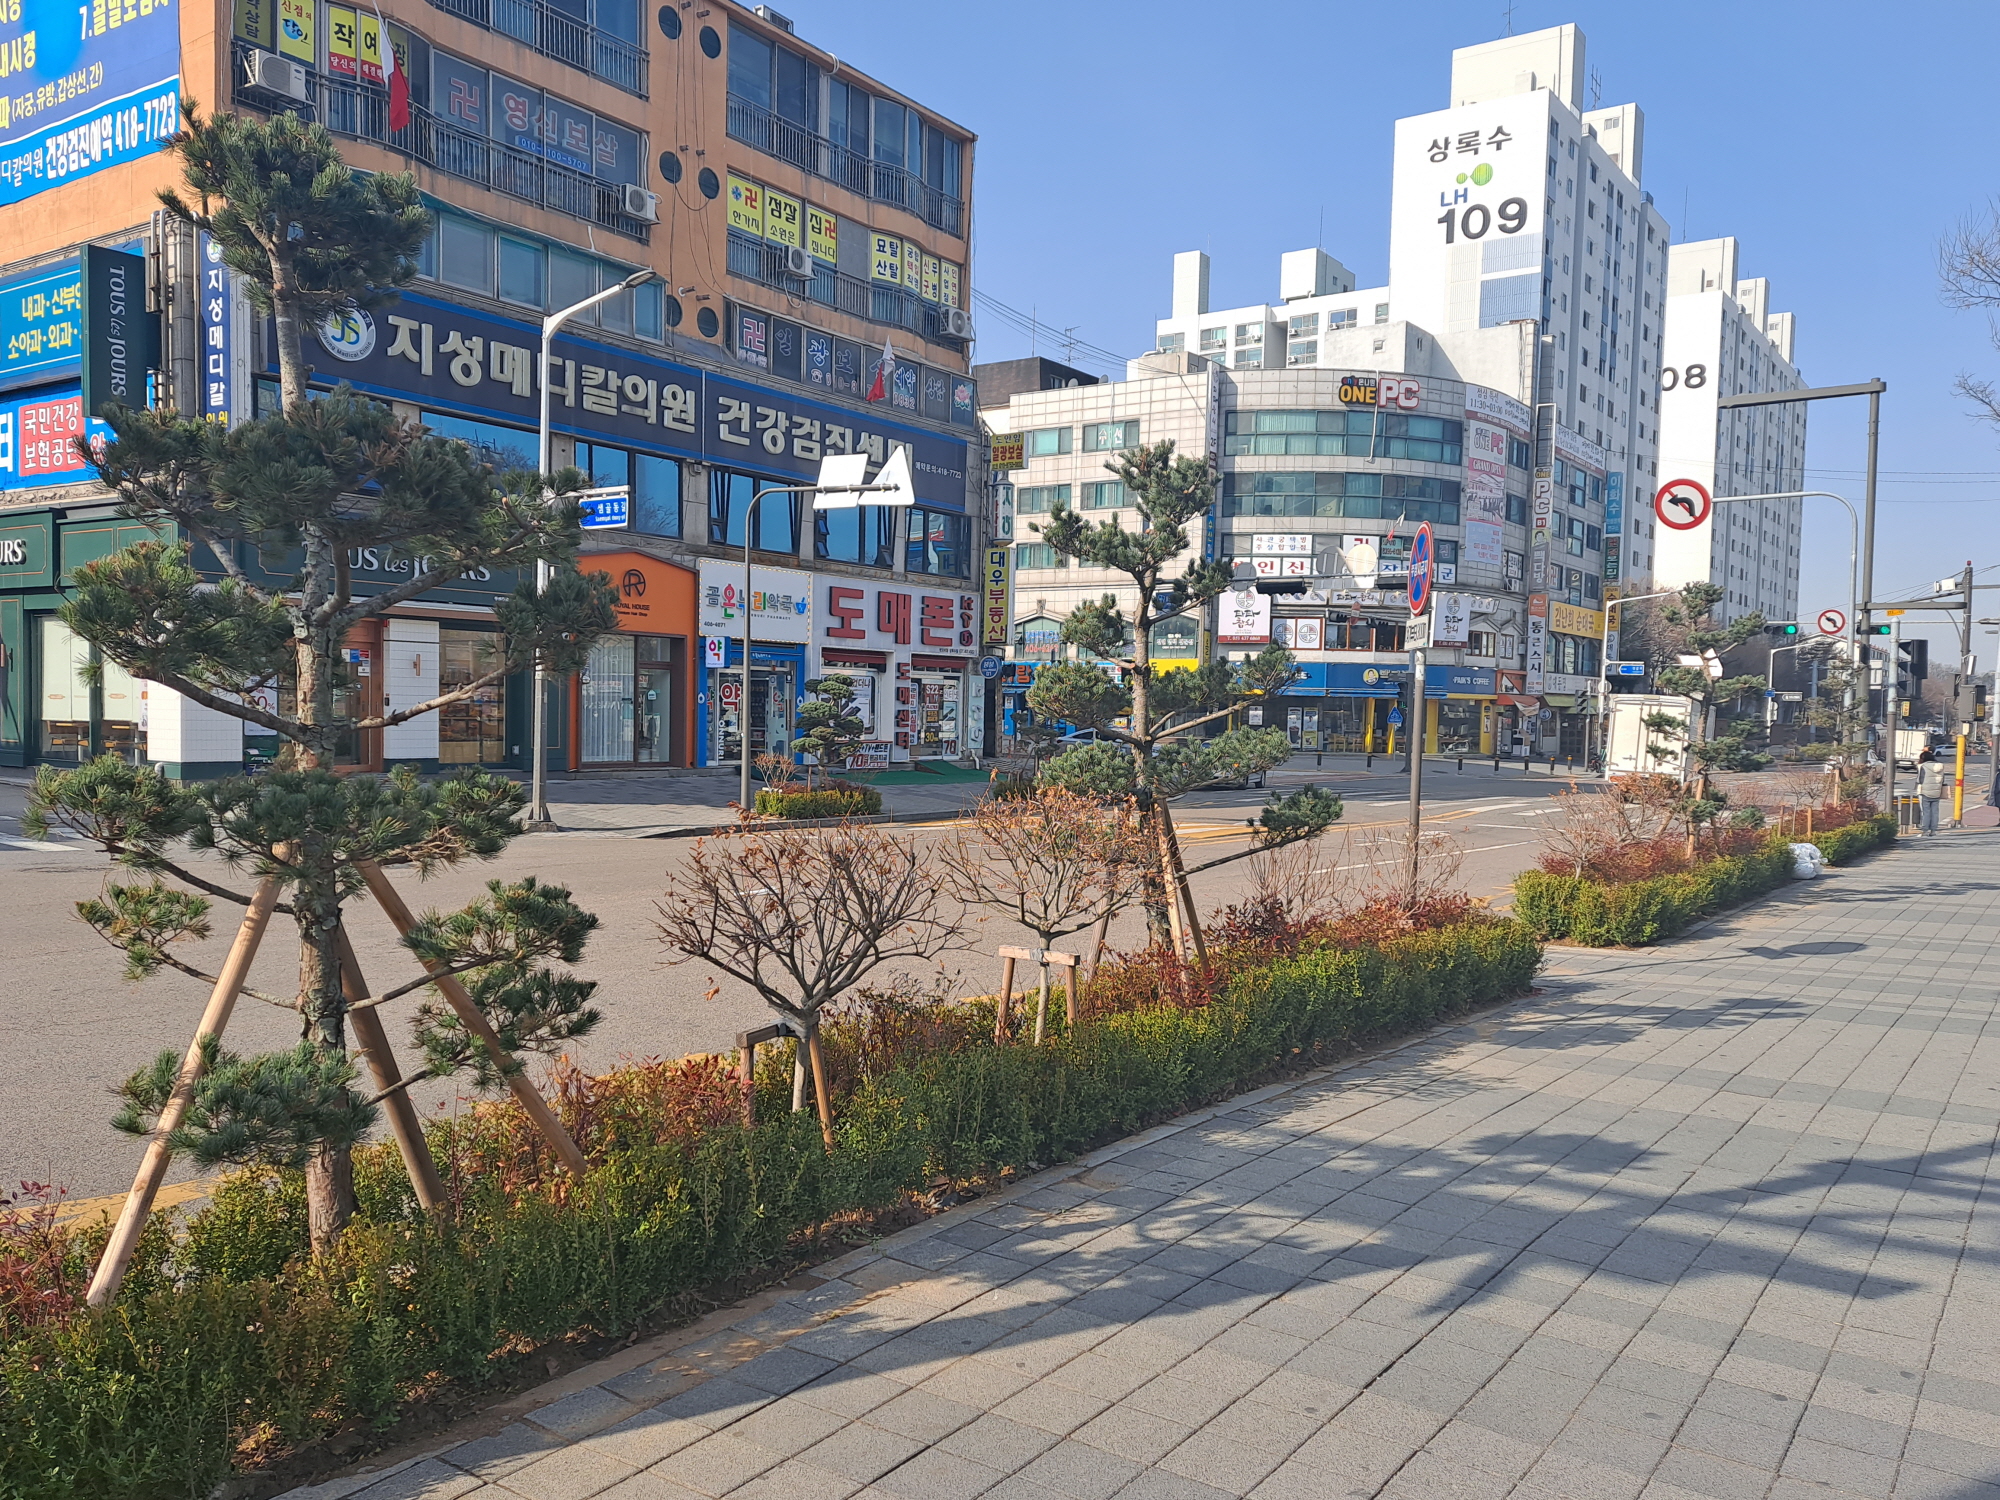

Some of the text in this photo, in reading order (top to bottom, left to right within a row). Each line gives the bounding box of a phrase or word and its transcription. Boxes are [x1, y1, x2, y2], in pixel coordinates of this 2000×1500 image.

[45, 113, 113, 180] 건강검진예약
[115, 91, 176, 152] 418-7723
[503, 92, 619, 168] 영신보살
[1427, 125, 1512, 163] 상록수
[1437, 197, 1528, 244] 109
[1440, 188, 1468, 207] LH
[106, 266, 127, 396] TOUS les JOURS
[208, 269, 226, 407] 지성메디칼
[386, 315, 696, 433] 지성메디칼의원
[1339, 378, 1420, 410] ONE PC
[24, 402, 79, 436] 국민건강
[24, 436, 78, 470] 보험공단
[992, 444, 1023, 462] 일광보살
[1534, 481, 1550, 514] PC
[827, 586, 954, 646] 도매폰
[986, 551, 1006, 644] 대우부동산
[708, 640, 722, 662] 약
[1529, 620, 1544, 674] 통큰스시
